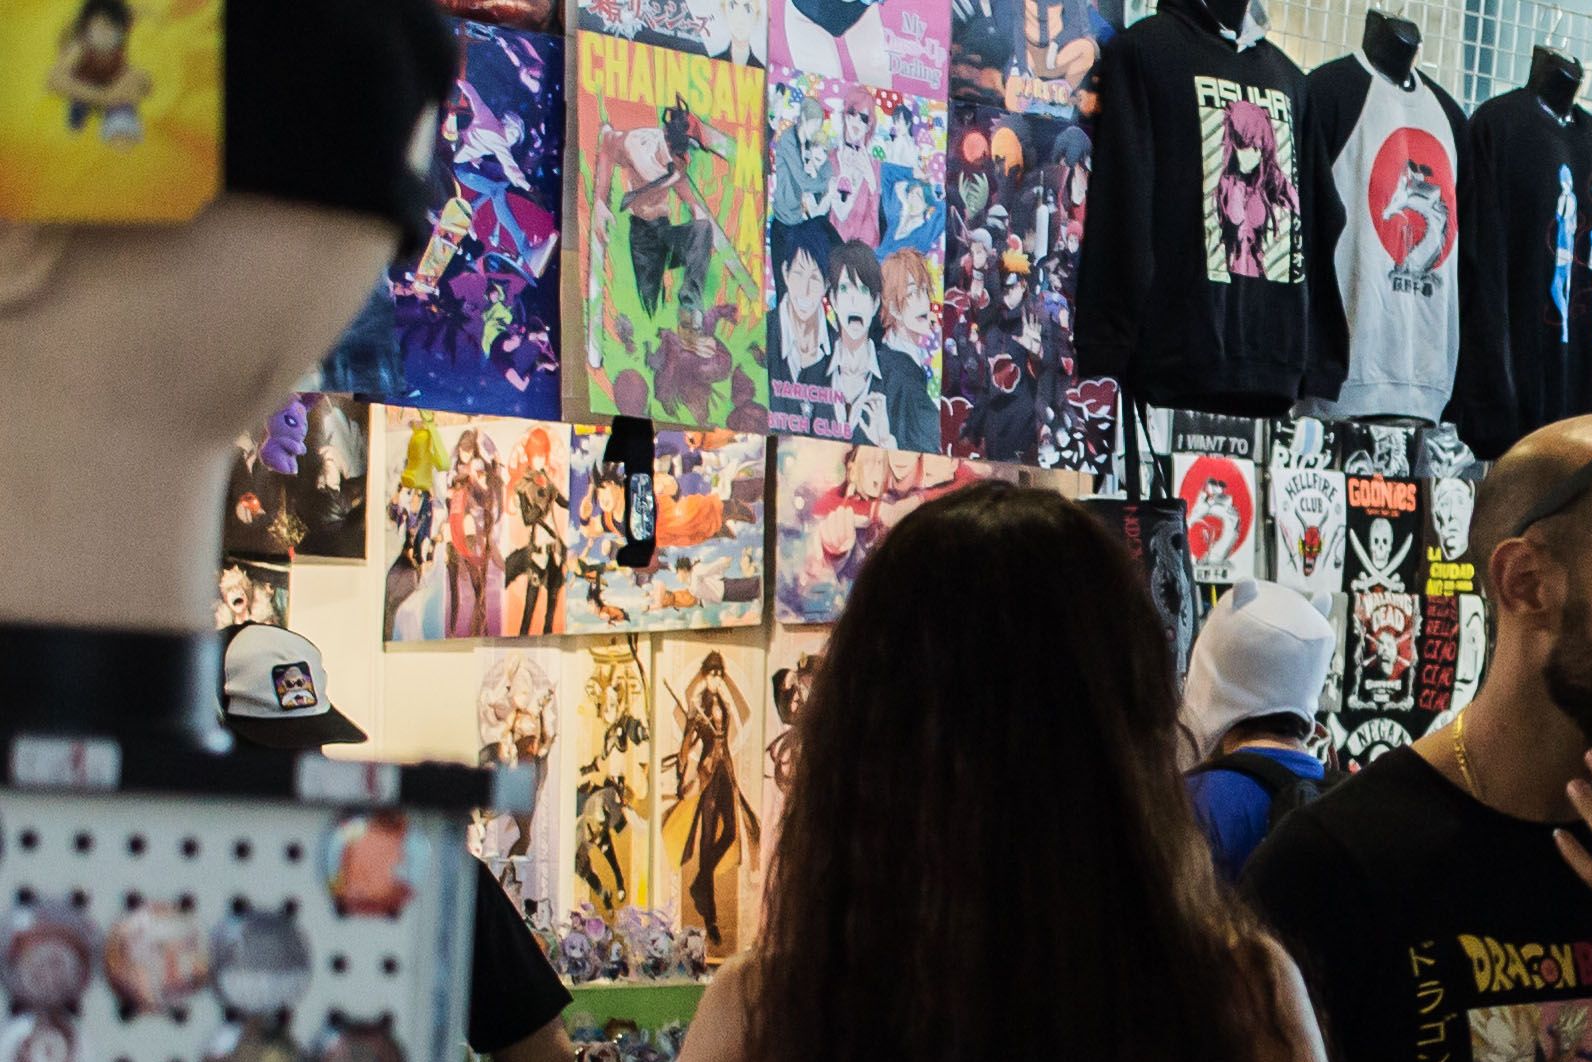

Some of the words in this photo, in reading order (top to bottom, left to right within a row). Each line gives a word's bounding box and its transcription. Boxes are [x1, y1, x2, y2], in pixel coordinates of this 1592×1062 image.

[902, 11, 928, 40] My
[581, 31, 765, 127] CHAINSAW
[885, 50, 941, 89] Darling
[771, 379, 846, 405] YARICHIN
[1186, 434, 1225, 451] WANT
[1227, 437, 1249, 455] TO
[1285, 472, 1339, 503] HELLFIRE
[1299, 497, 1324, 513] CLUB
[1457, 933, 1577, 993] DRAGON
